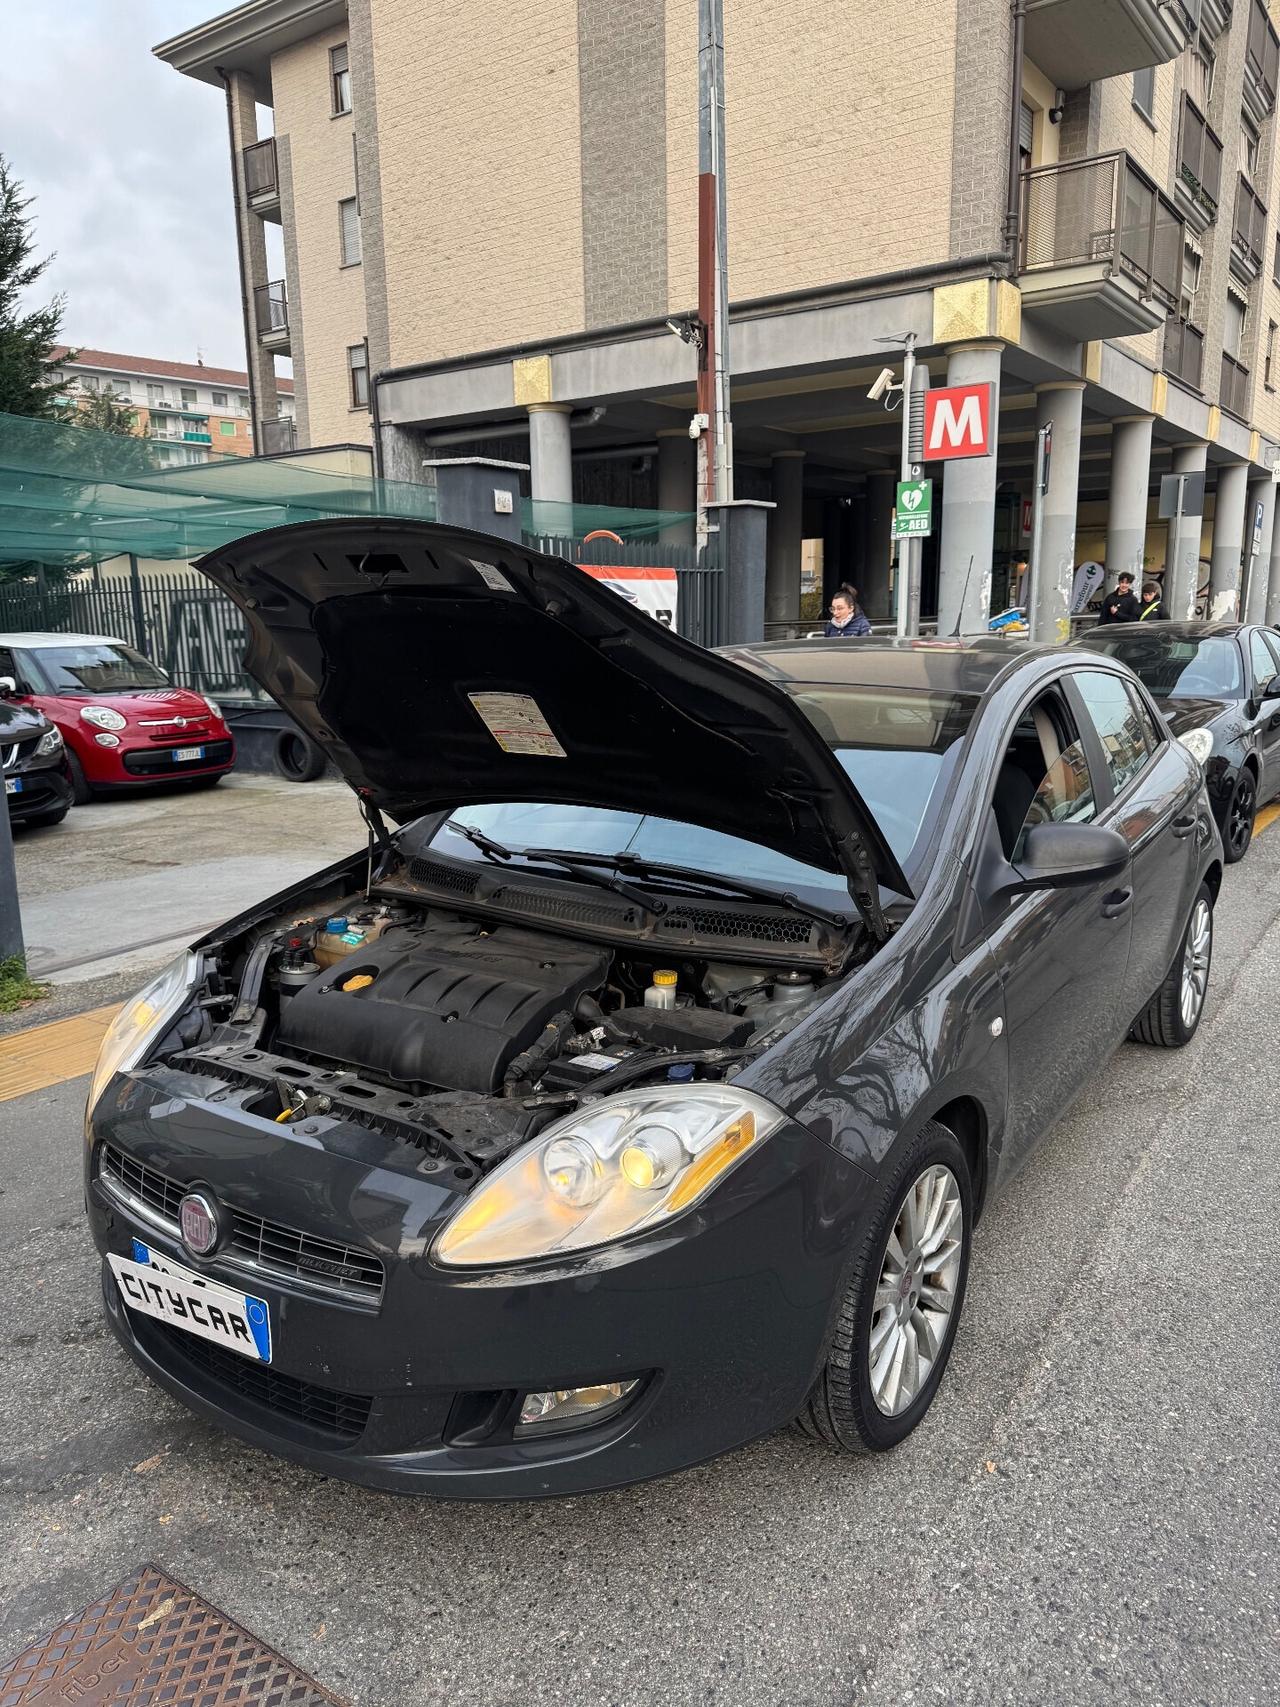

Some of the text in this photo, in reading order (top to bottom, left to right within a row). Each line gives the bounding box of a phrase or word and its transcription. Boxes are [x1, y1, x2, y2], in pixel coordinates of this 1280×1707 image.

[929, 395, 984, 450] M
[908, 519, 928, 531] AED
[184, 1209, 209, 1243] FIAT
[120, 1271, 251, 1344] CITYCAR
